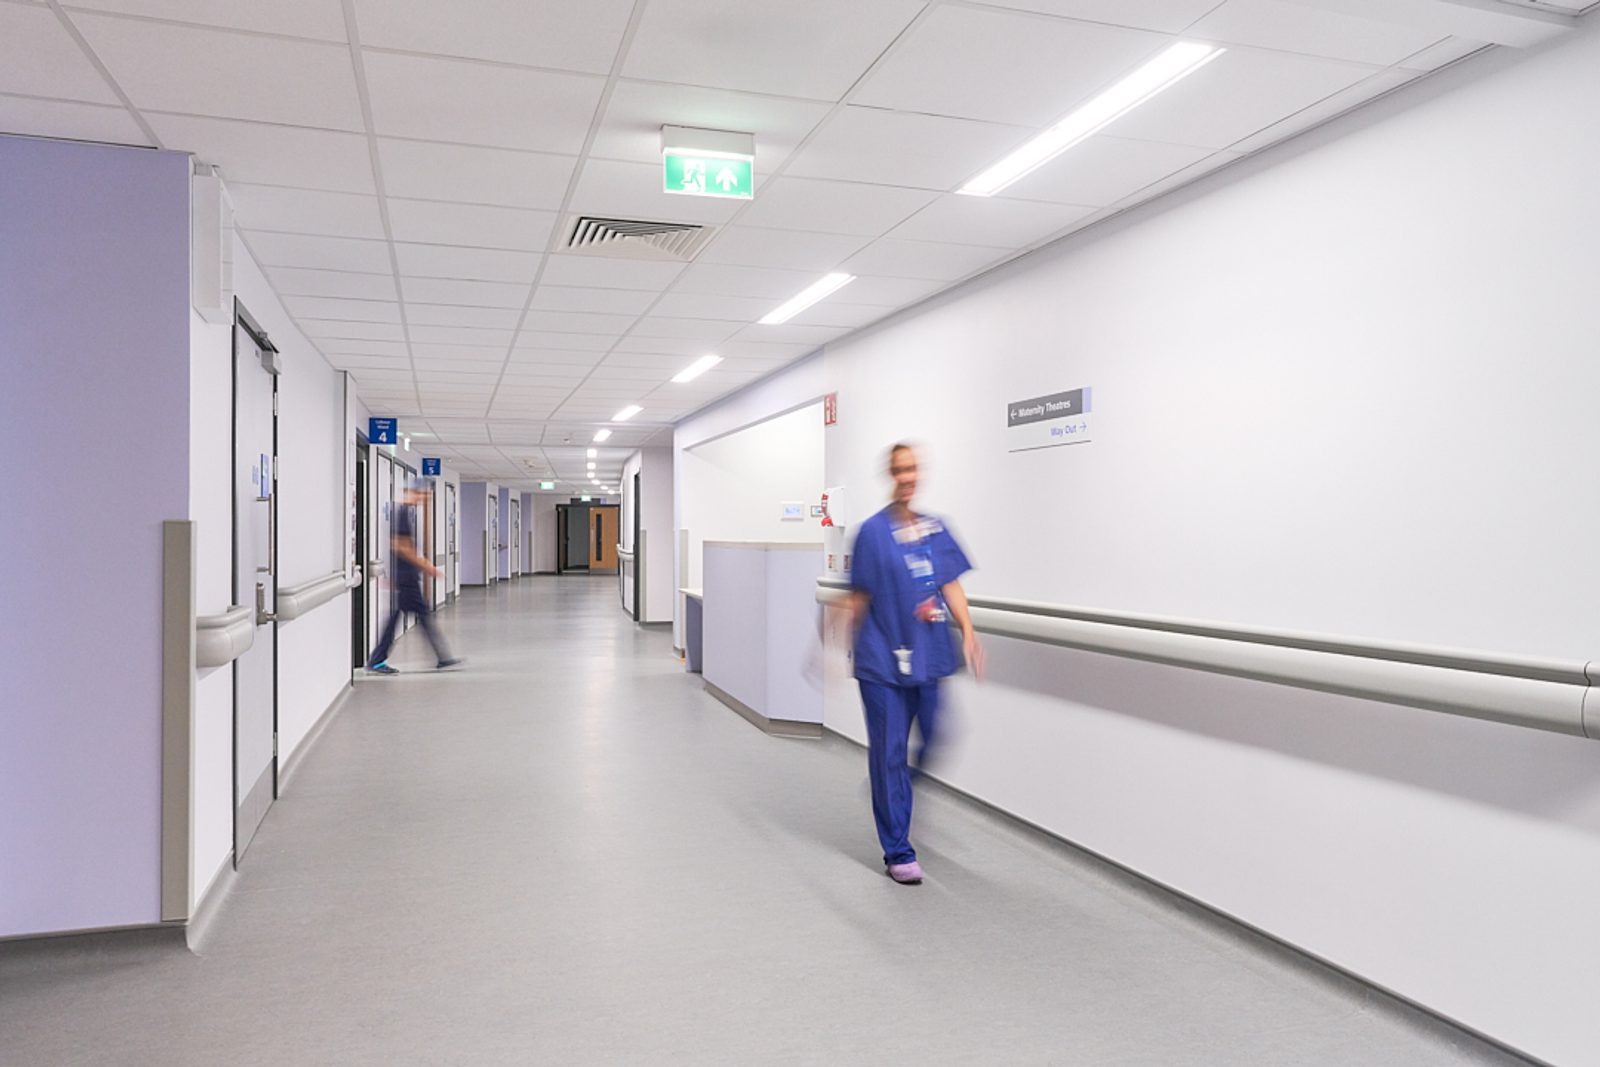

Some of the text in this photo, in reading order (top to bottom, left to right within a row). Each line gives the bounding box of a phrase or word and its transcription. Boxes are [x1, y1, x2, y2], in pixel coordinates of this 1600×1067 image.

[1018, 400, 1071, 417] Maternity Theatres
[379, 431, 387, 442] 4
[1050, 424, 1077, 437] Way Out
